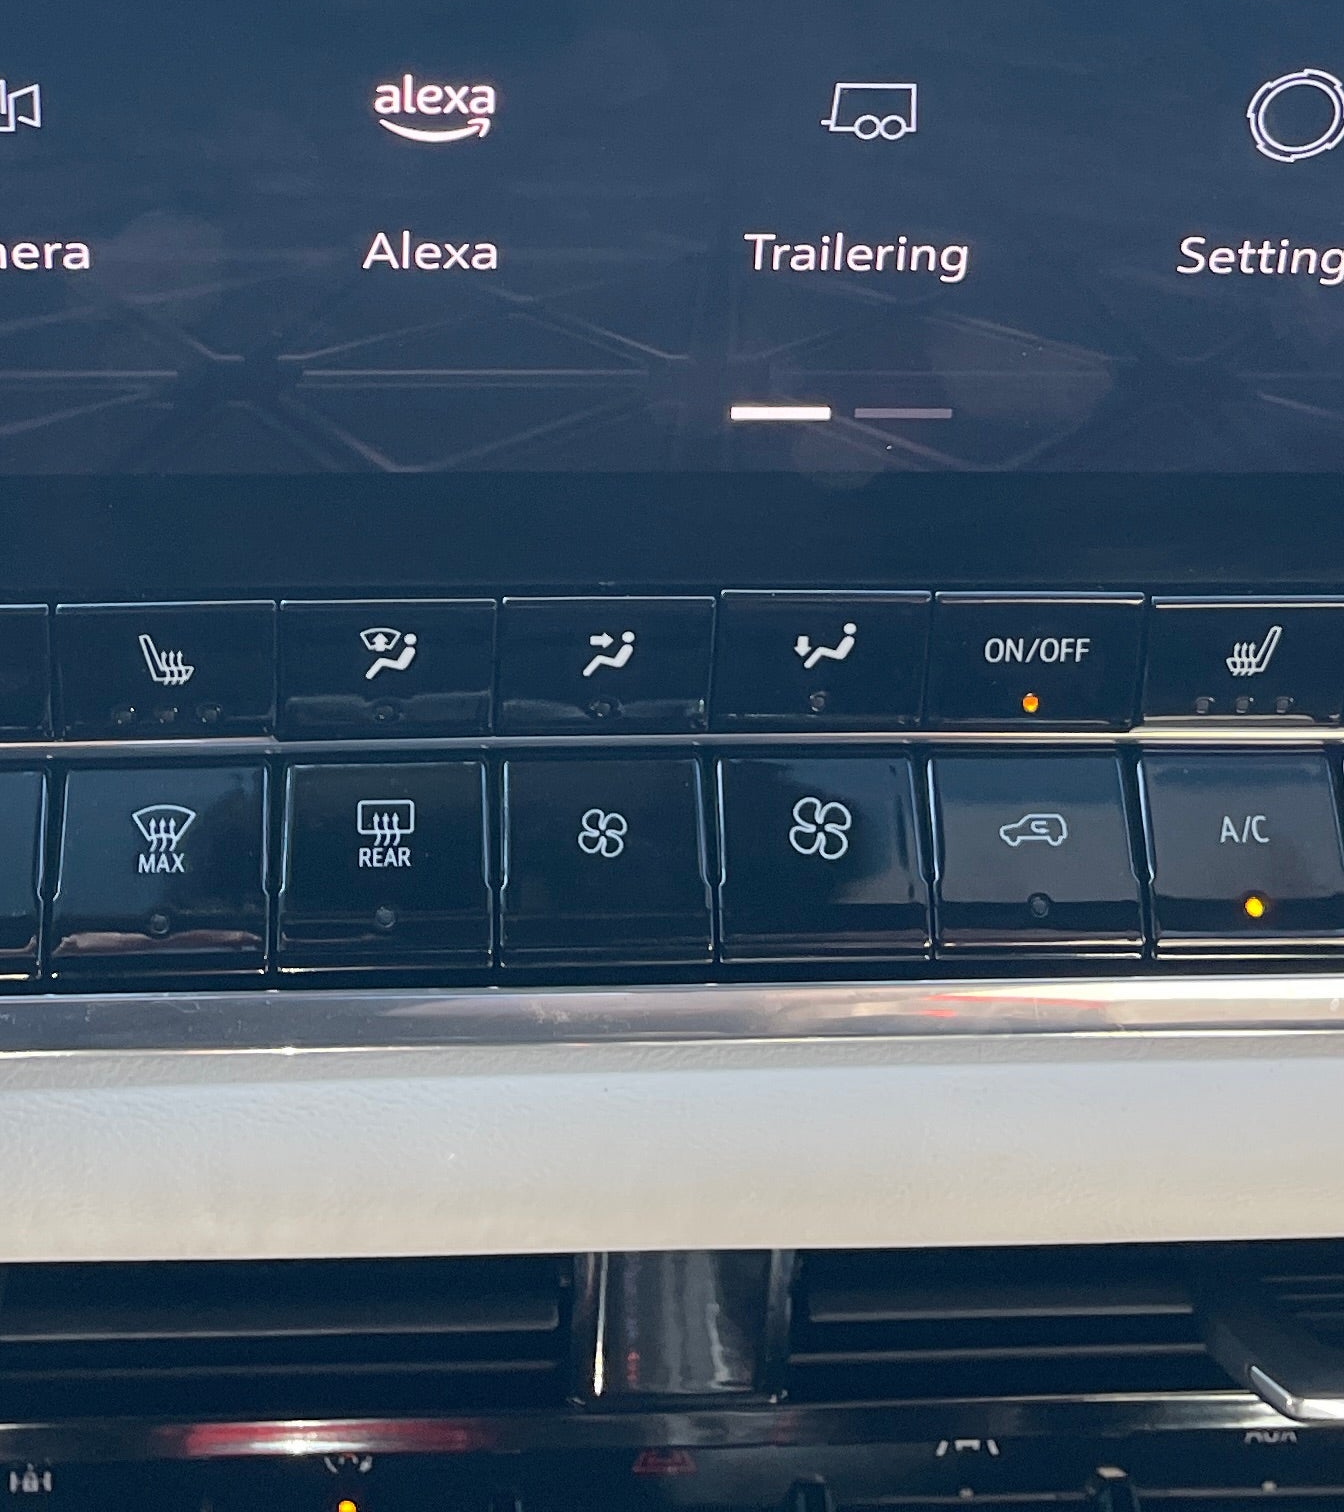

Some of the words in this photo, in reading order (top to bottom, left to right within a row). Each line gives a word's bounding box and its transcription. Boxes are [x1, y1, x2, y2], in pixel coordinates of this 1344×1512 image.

[373, 73, 496, 116] alexa
[362, 230, 498, 270] Alexa
[743, 231, 969, 283] Trailering
[984, 637, 1091, 664] ON/OFF
[1219, 815, 1270, 844] A/C
[138, 852, 186, 875] MAX
[358, 846, 412, 869] REAR
